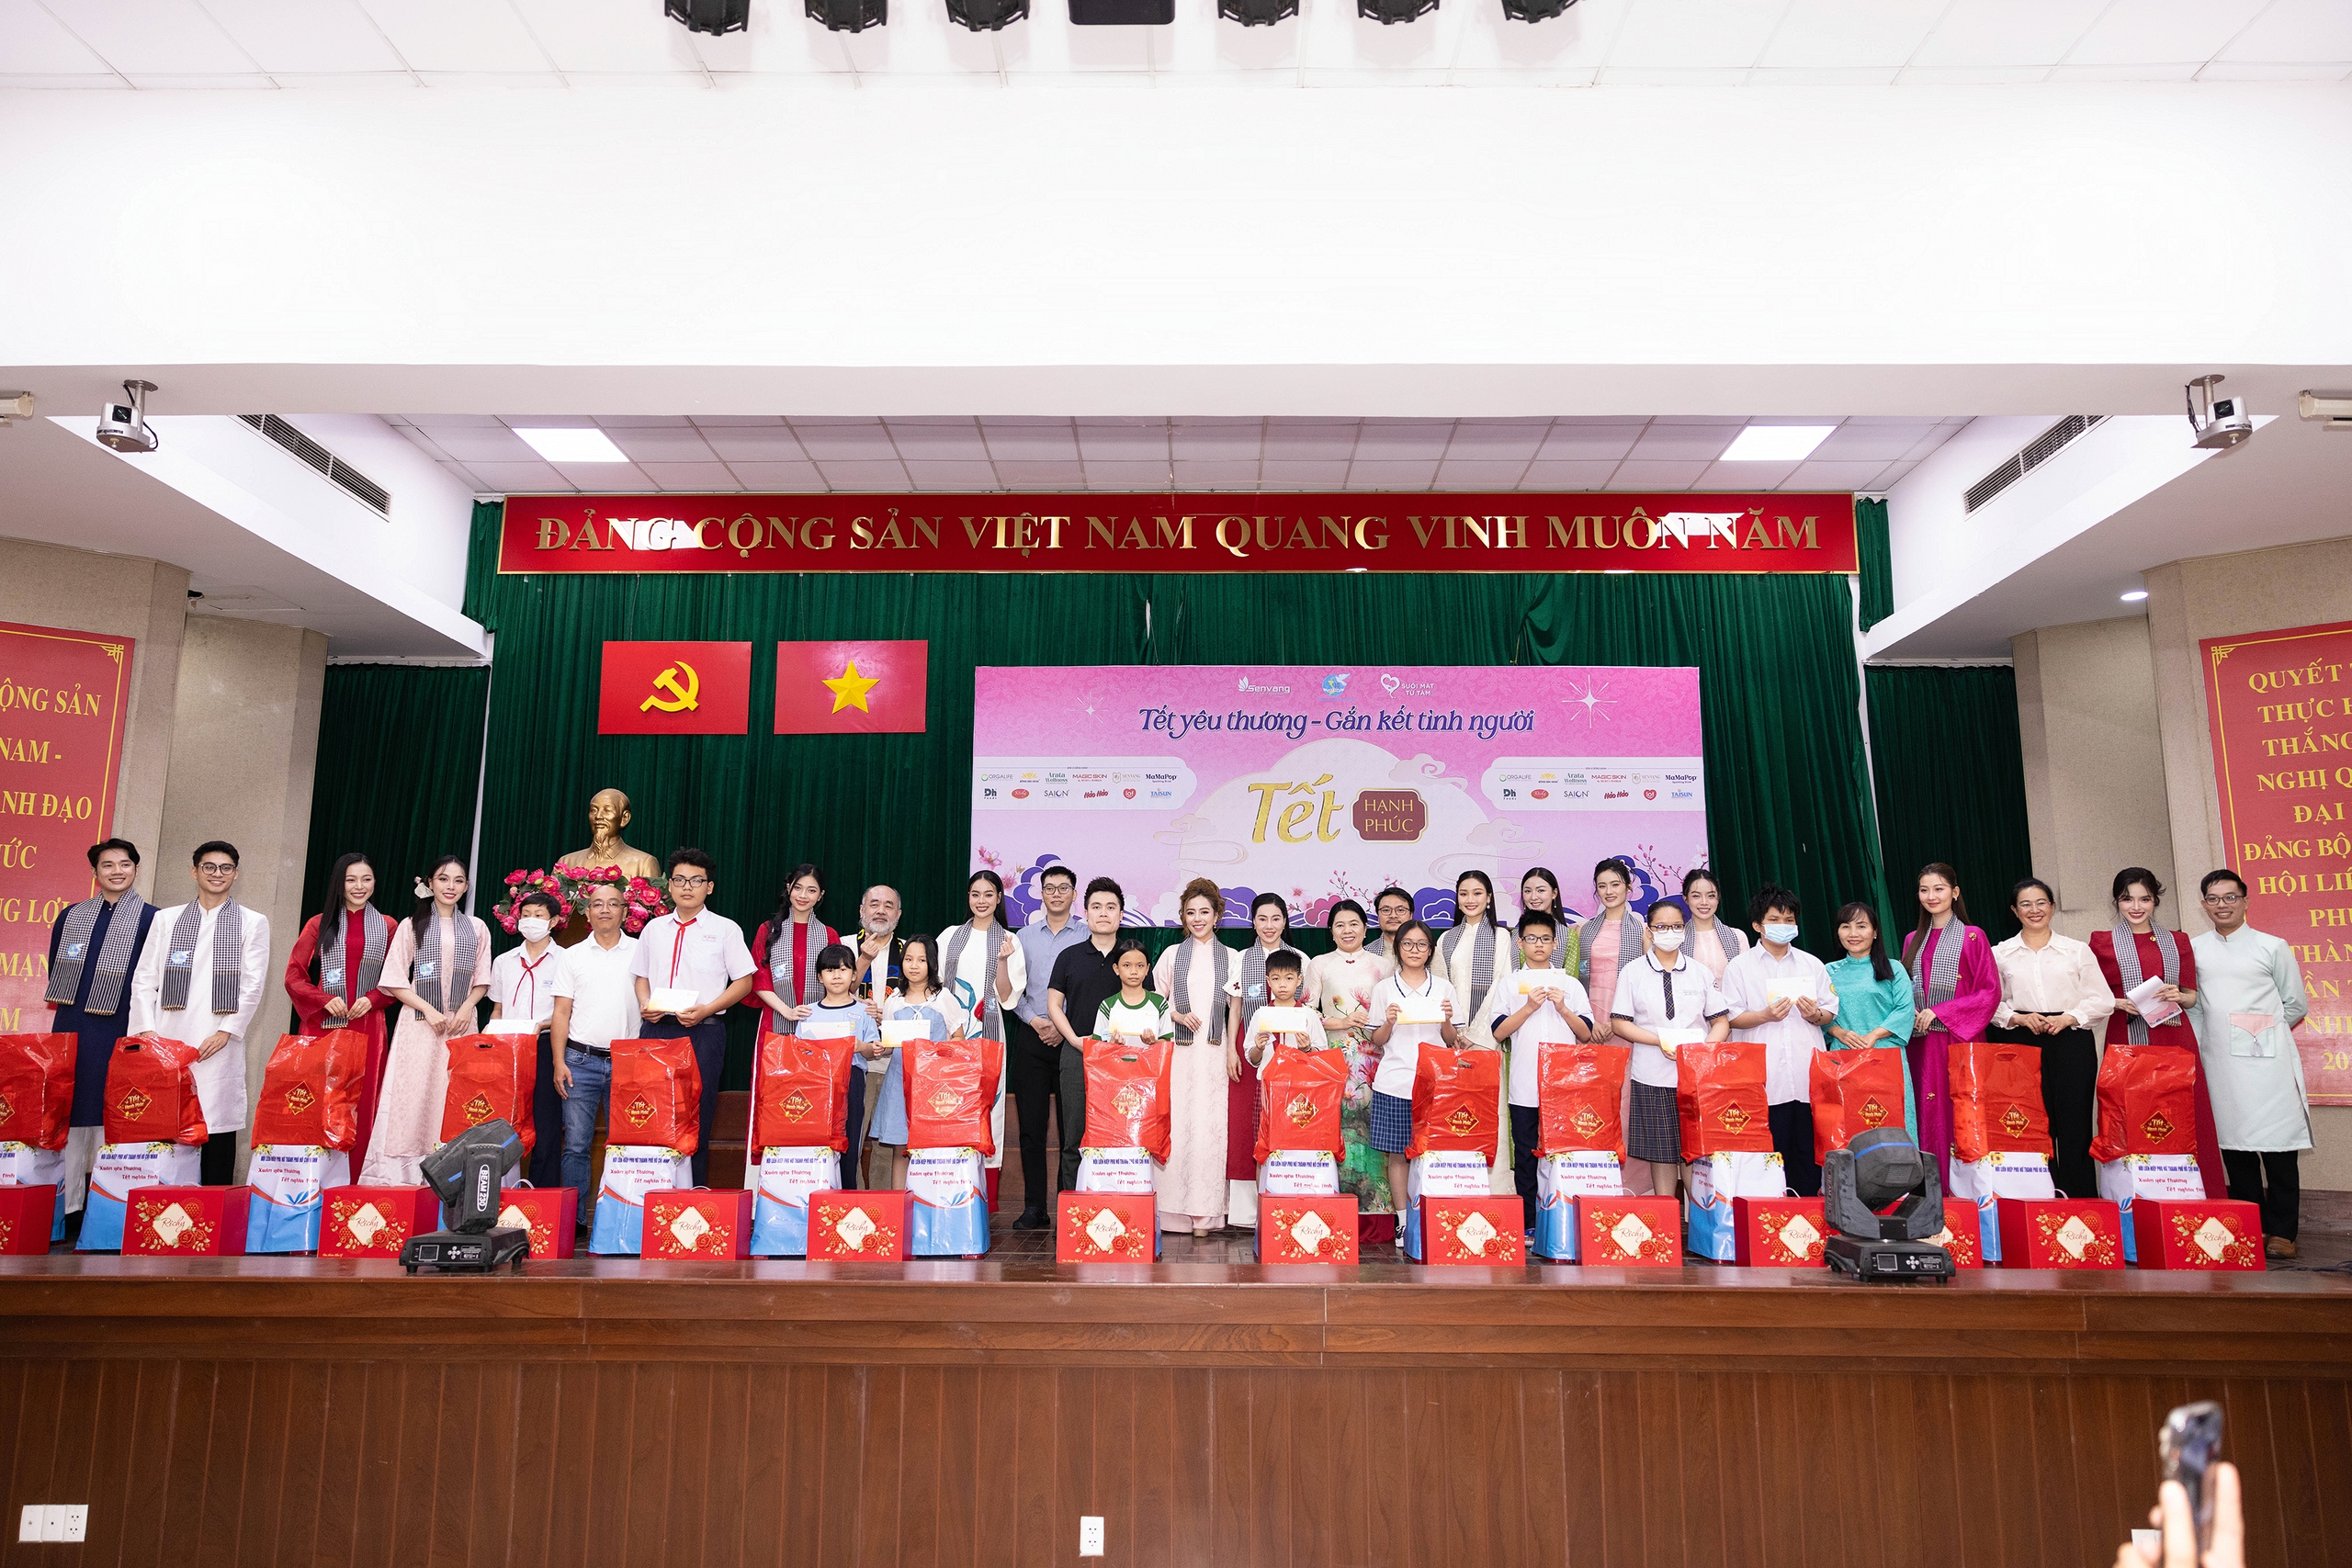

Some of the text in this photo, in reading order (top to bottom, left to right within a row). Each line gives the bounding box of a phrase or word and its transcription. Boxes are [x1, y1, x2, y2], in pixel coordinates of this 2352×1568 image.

[534, 506, 1825, 558] ĐẢNG CỘNG SẢN VIỆT NAM QUANG VINH MUÔN NĂM
[2248, 658, 2343, 694] QUYẾT
[54, 682, 101, 716] SẢN
[2256, 697, 2335, 724] THỰC
[1139, 705, 1174, 732] Tết
[1168, 706, 1224, 739] yêu
[1227, 708, 1308, 740] thương
[1325, 705, 1373, 732] Gắn
[1376, 704, 1413, 732] kết
[1417, 709, 1464, 732] tình
[1467, 708, 1536, 741] người
[1665, 773, 1697, 782] MaMaPop
[2256, 768, 2328, 792] NGHỊ
[40, 793, 93, 824] ĐẠO
[1247, 773, 1344, 844] Tết
[1363, 798, 1414, 815] HẠNH
[2292, 802, 2346, 825] ĐẠI
[1363, 815, 1414, 833] PHÚC
[0, 837, 38, 870] ỨC
[2243, 831, 2351, 861] ĐẢNG BỘ
[2257, 870, 2308, 897] HỘI
[479, 1169, 488, 1207] BEAM 230
[161, 1216, 187, 1231] Richy
[356, 1216, 379, 1231] Richy
[678, 1221, 703, 1236] Richy
[844, 1221, 869, 1237] Richy
[1093, 1222, 1118, 1237] Richy
[1299, 1224, 1323, 1240] Richy
[1464, 1225, 1489, 1241] Richy
[1619, 1226, 1645, 1242] Richy
[1787, 1228, 1813, 1245] Richy
[2064, 1230, 2088, 1246] Richy
[2201, 1231, 2227, 1247] Richy
